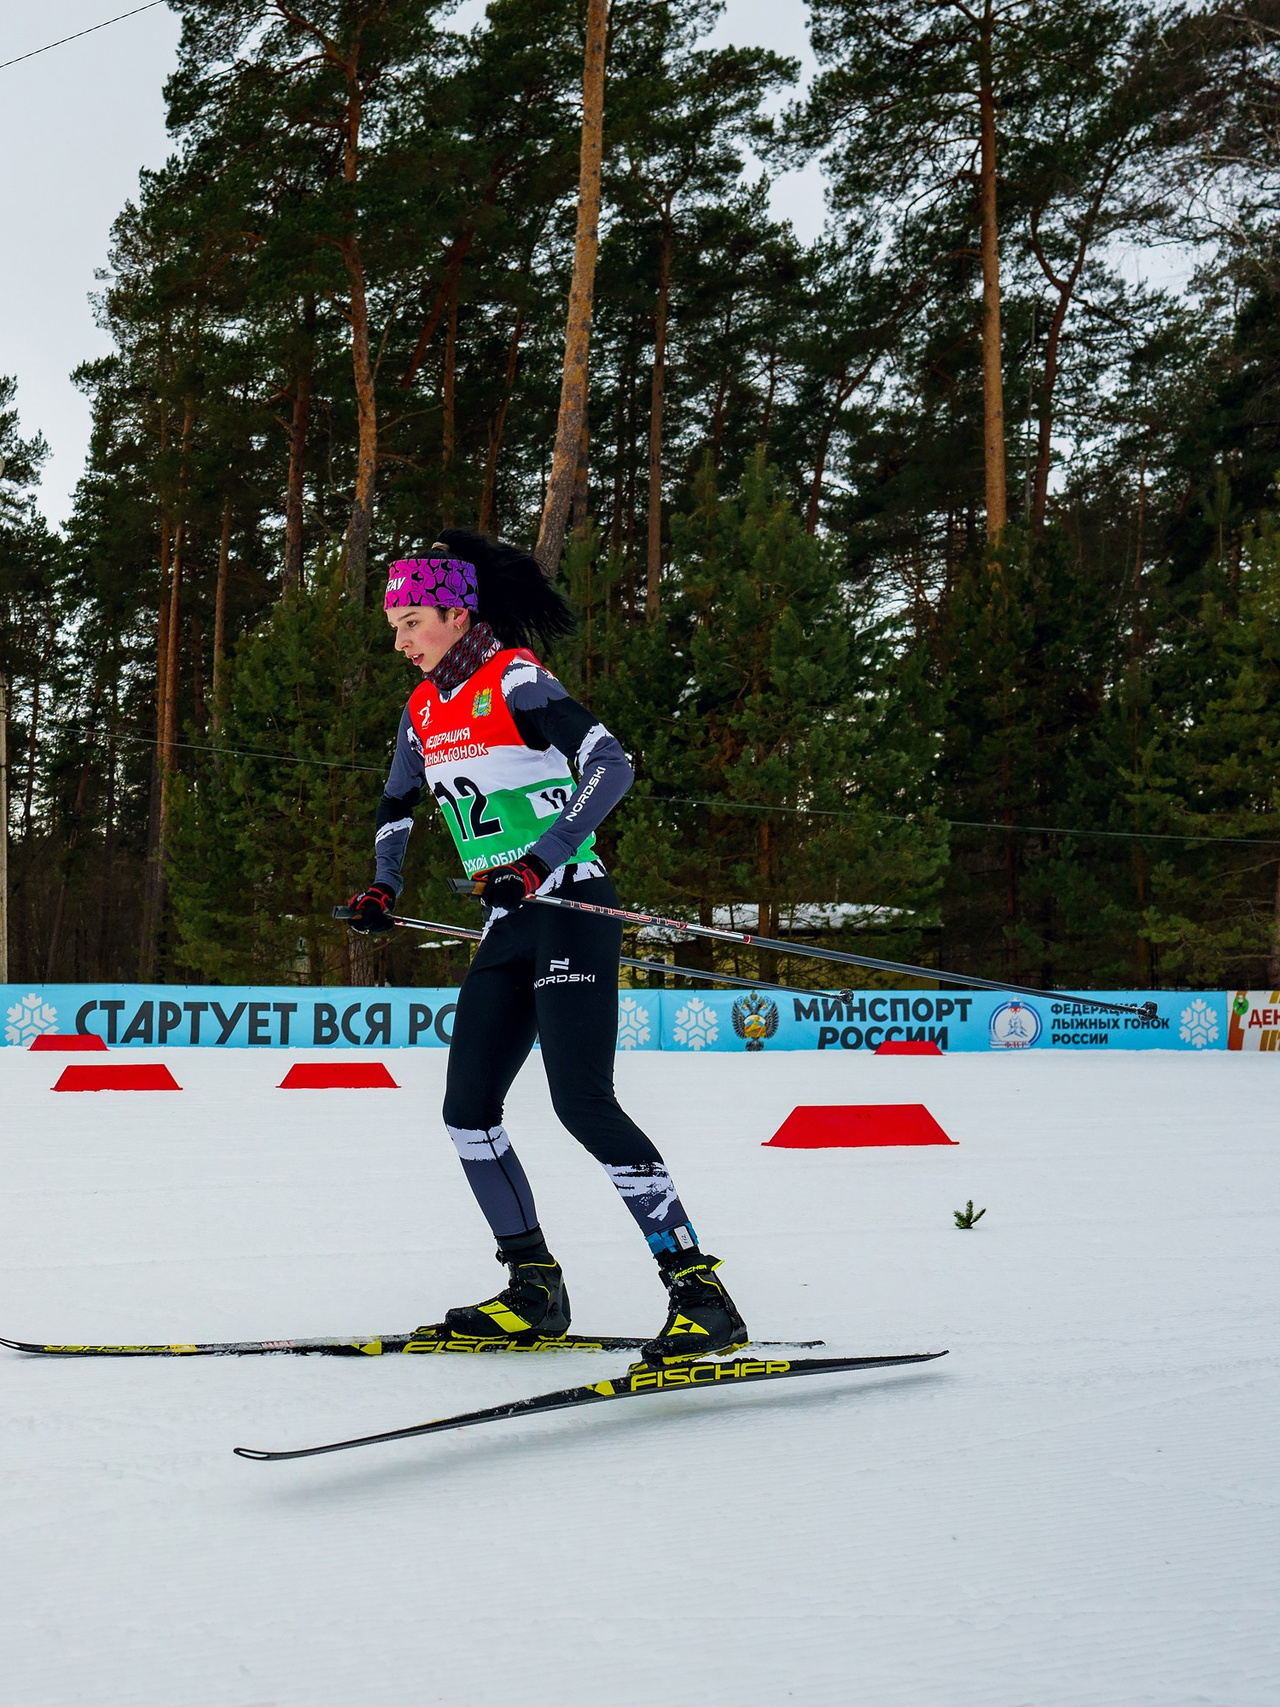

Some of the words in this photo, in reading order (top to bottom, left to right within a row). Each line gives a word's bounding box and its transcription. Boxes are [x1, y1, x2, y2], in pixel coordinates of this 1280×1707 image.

[448, 742, 489, 762] ГОНОК
[565, 766, 607, 822] NORDSKI
[433, 776, 504, 841] 12
[533, 974, 595, 990] NORDSKI
[793, 998, 972, 1022] МИНСПОРТ
[75, 1000, 298, 1045] СТАРТУЕТ
[313, 1002, 391, 1045] ВСЯ
[1051, 1018, 1120, 1029] ЛЫЖНЫХ
[1124, 1018, 1170, 1029] ГОНОК
[818, 1026, 948, 1050] РОССИИ
[1052, 1033, 1108, 1045] РОССИИ
[631, 1360, 790, 1392] FISCHER
